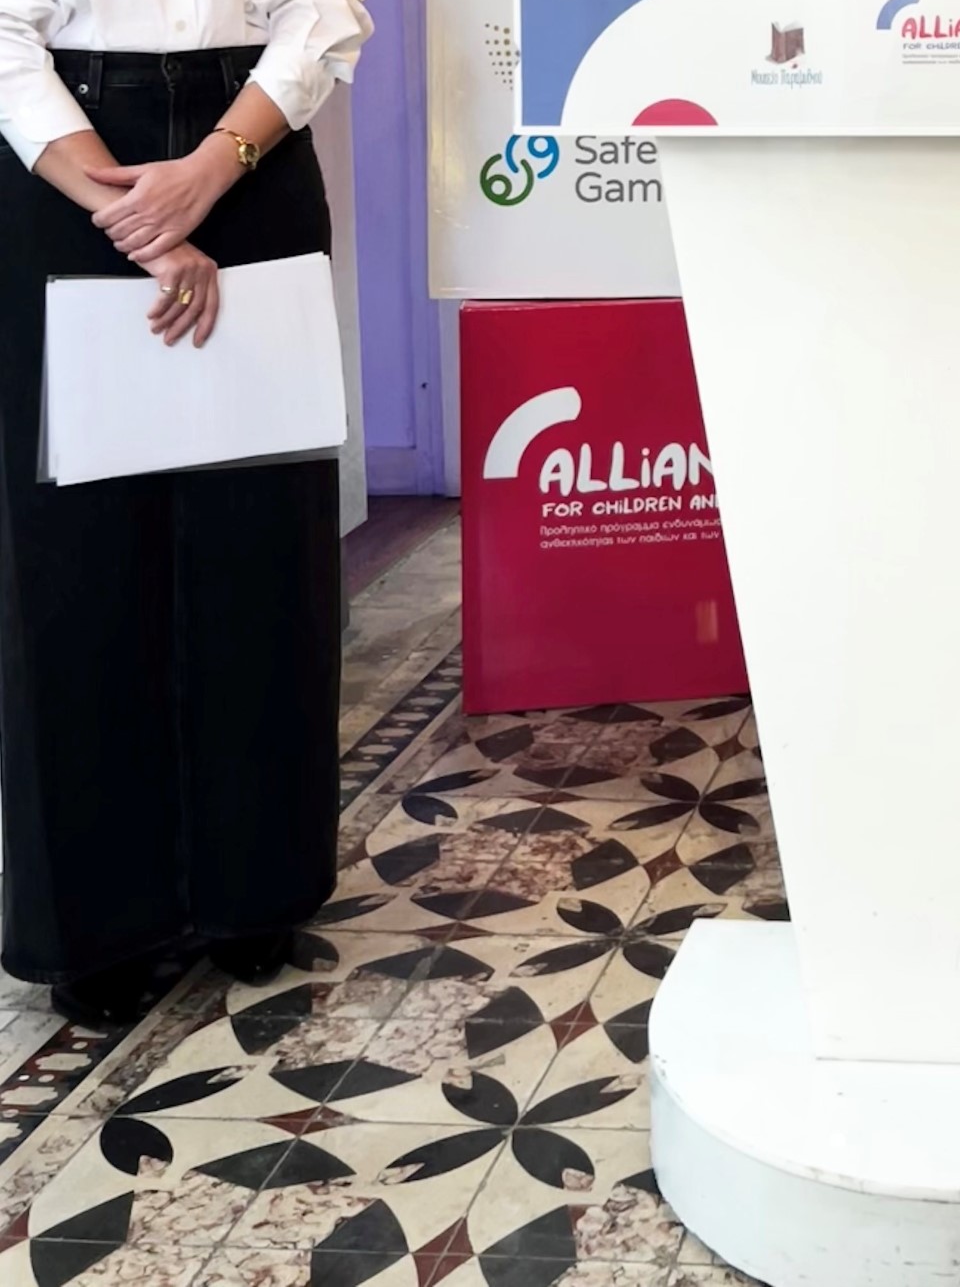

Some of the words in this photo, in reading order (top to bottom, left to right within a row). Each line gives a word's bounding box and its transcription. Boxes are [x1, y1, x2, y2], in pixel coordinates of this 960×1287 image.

[574, 135, 659, 166] Safe
[538, 440, 714, 497] ALLiAN
[541, 501, 584, 518] FOR
